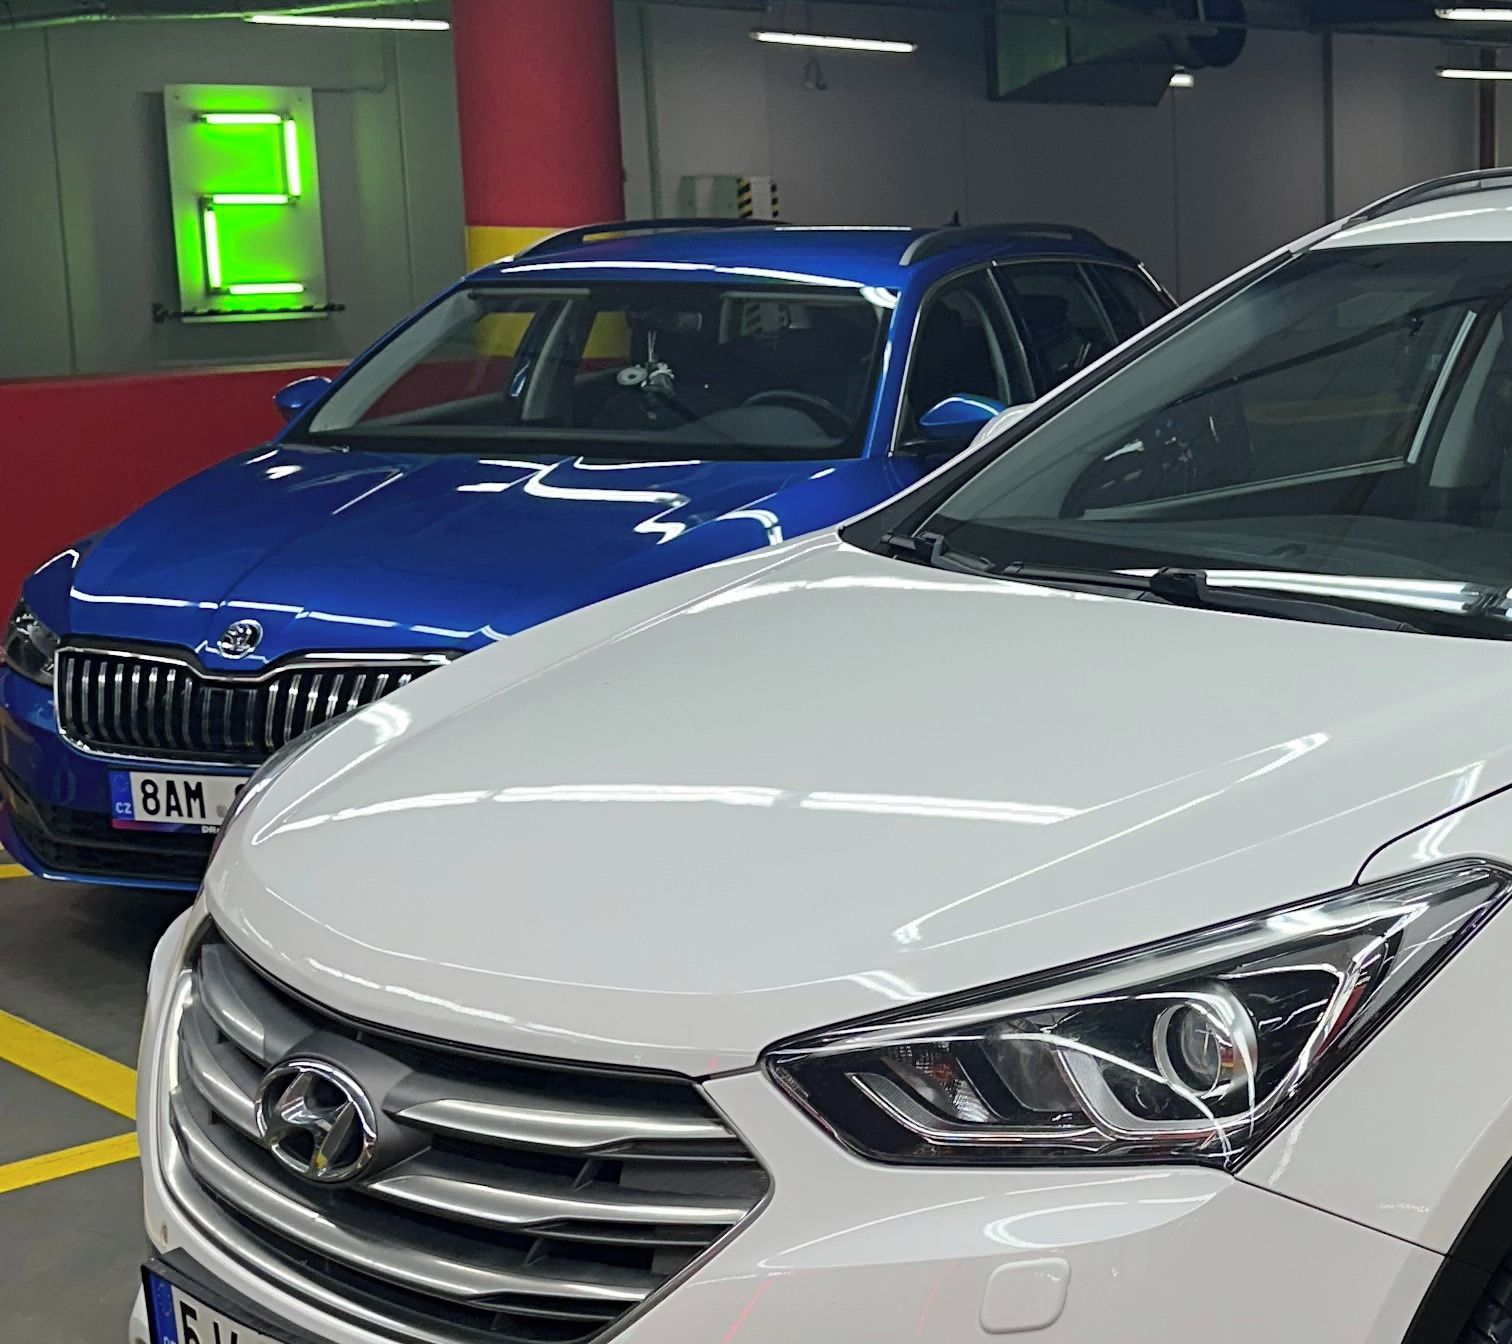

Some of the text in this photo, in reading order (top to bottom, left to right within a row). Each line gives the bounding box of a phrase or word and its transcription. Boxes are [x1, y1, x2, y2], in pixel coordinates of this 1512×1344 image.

[200, 112, 304, 296] 2
[115, 801, 132, 814] CZ
[140, 778, 206, 819] 8AM
